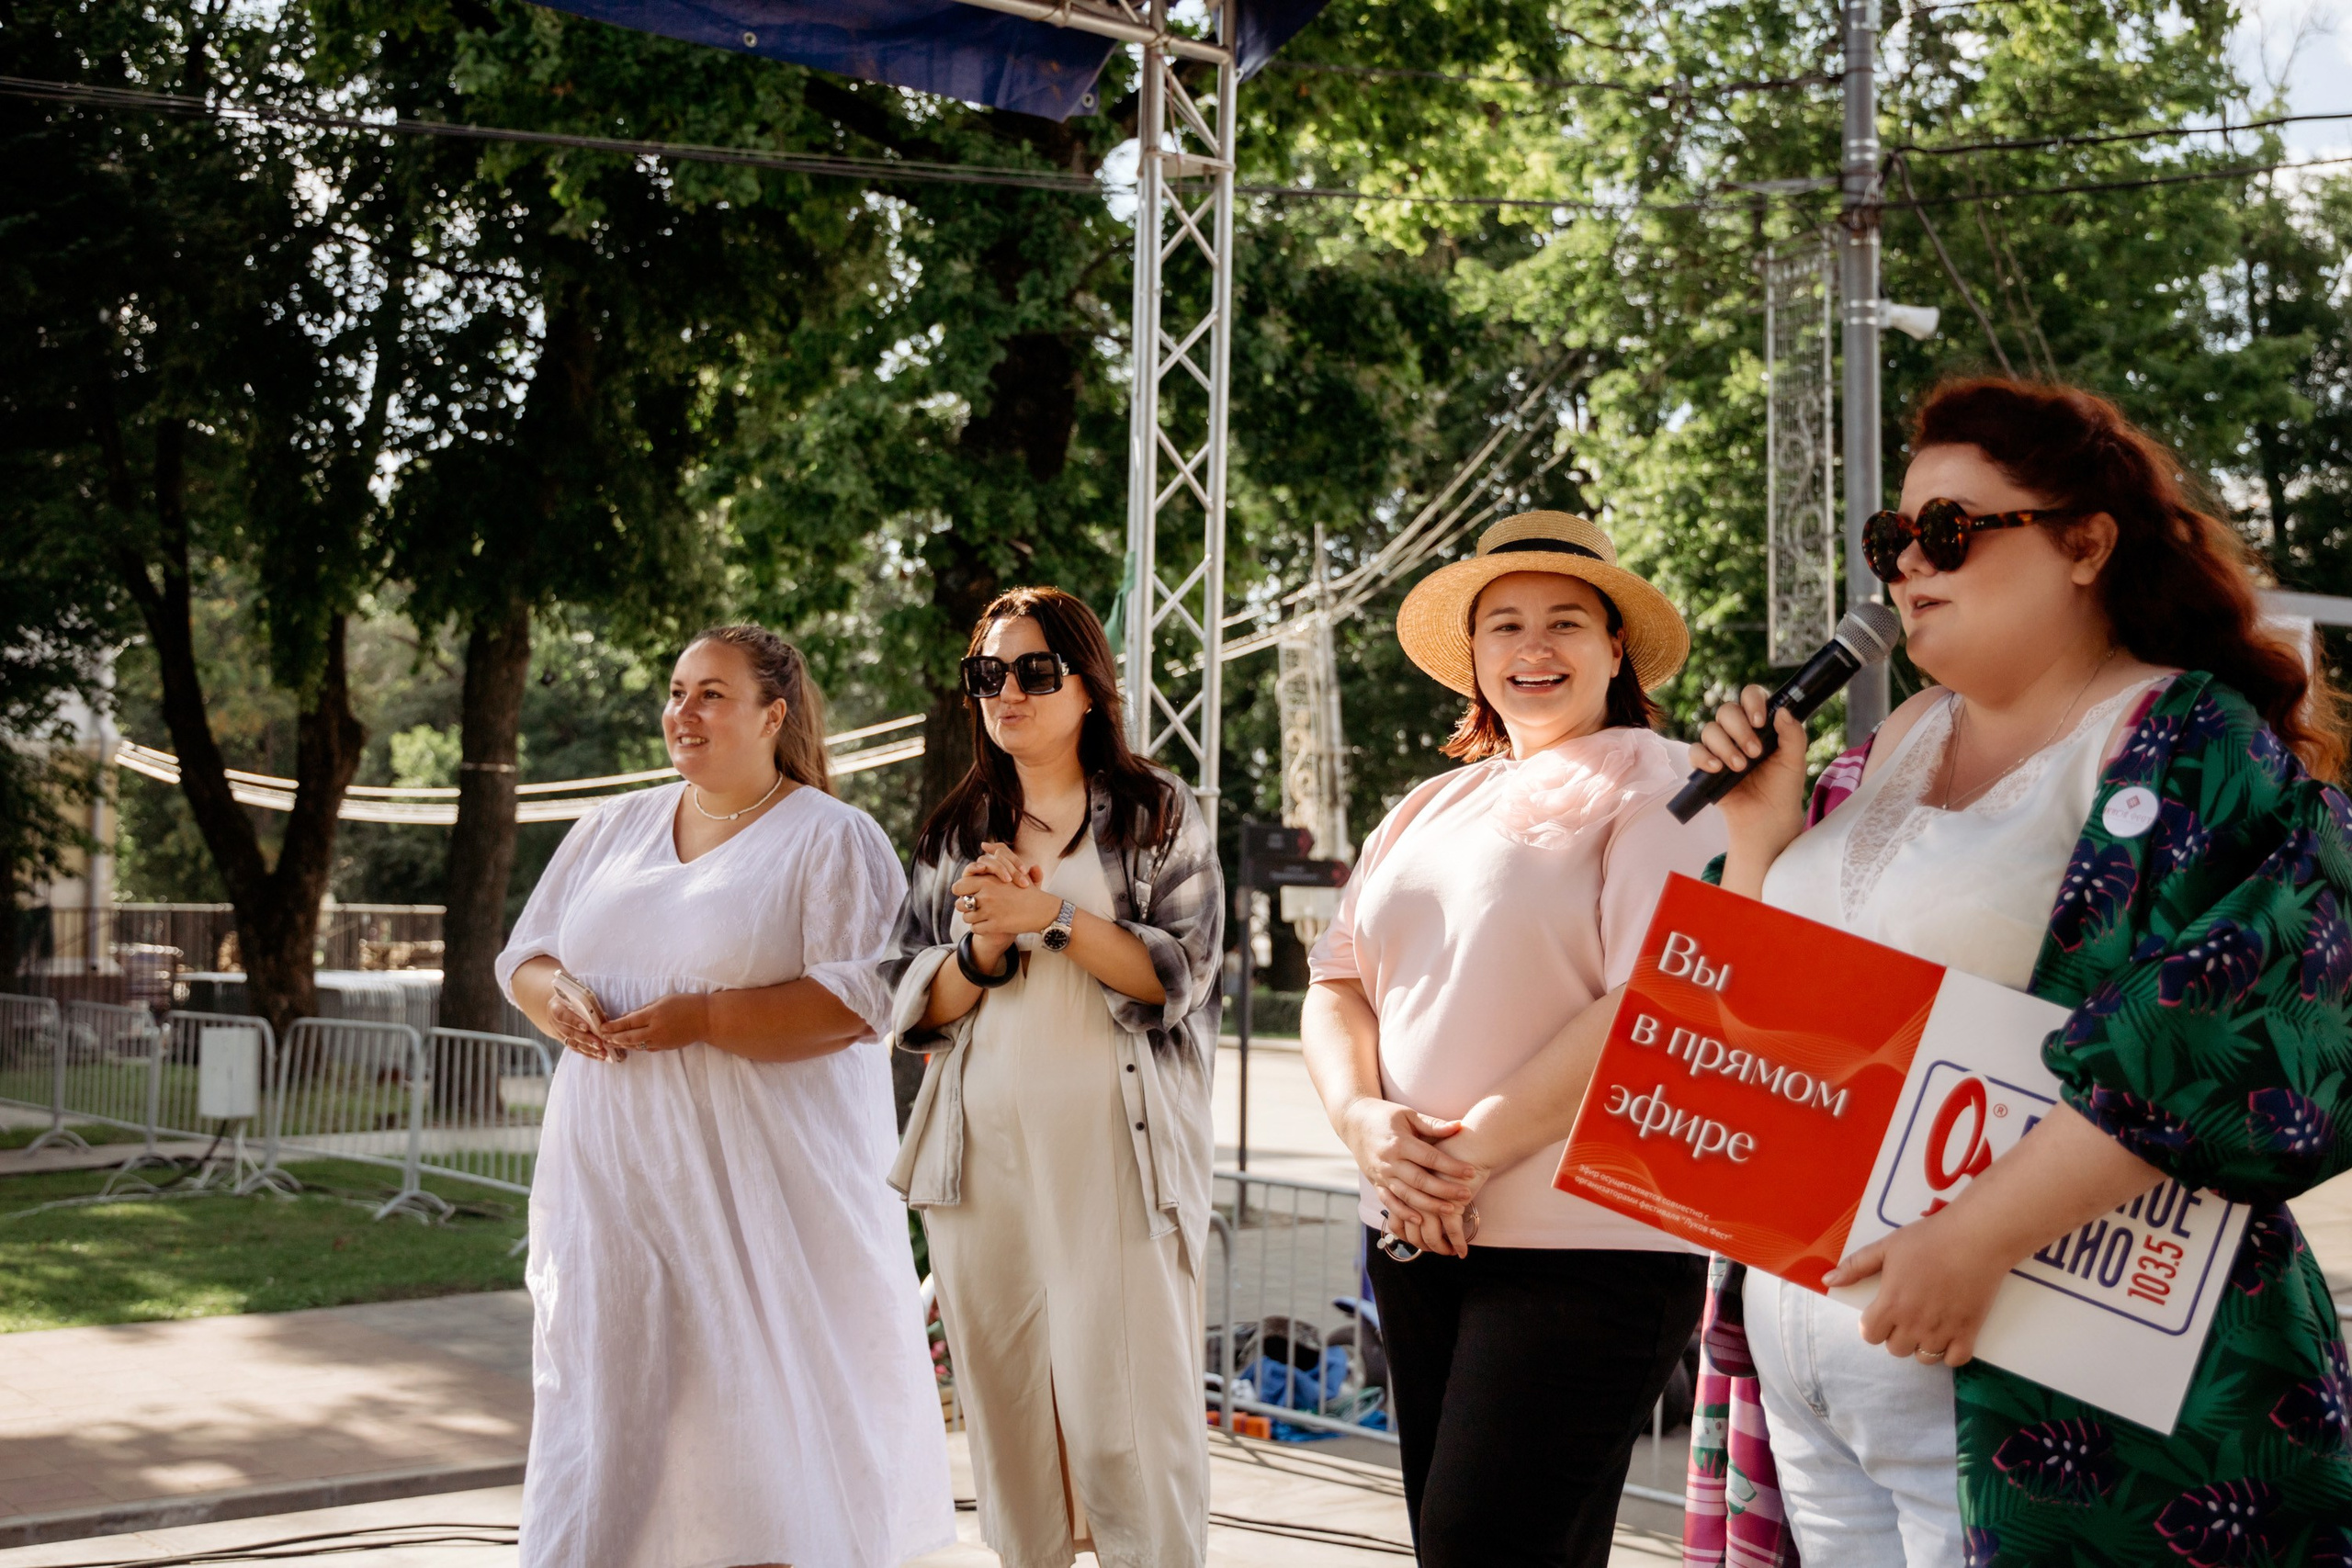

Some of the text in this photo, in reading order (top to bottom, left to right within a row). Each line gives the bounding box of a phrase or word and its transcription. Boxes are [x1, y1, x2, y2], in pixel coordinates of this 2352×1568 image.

[1657, 931, 1729, 992] Вы
[1630, 1013, 1848, 1117] в прямом
[1604, 1084, 1755, 1162] эфире
[1575, 1176, 1639, 1205] организаторами
[1639, 1200, 1680, 1222] фестиваля
[1578, 1164, 1600, 1179] Эфир
[1600, 1174, 1661, 1202] осуществляется
[1661, 1197, 1704, 1219] совместно
[2033, 1219, 2134, 1288] ДИО
[2127, 1234, 2184, 1306] 103.5
